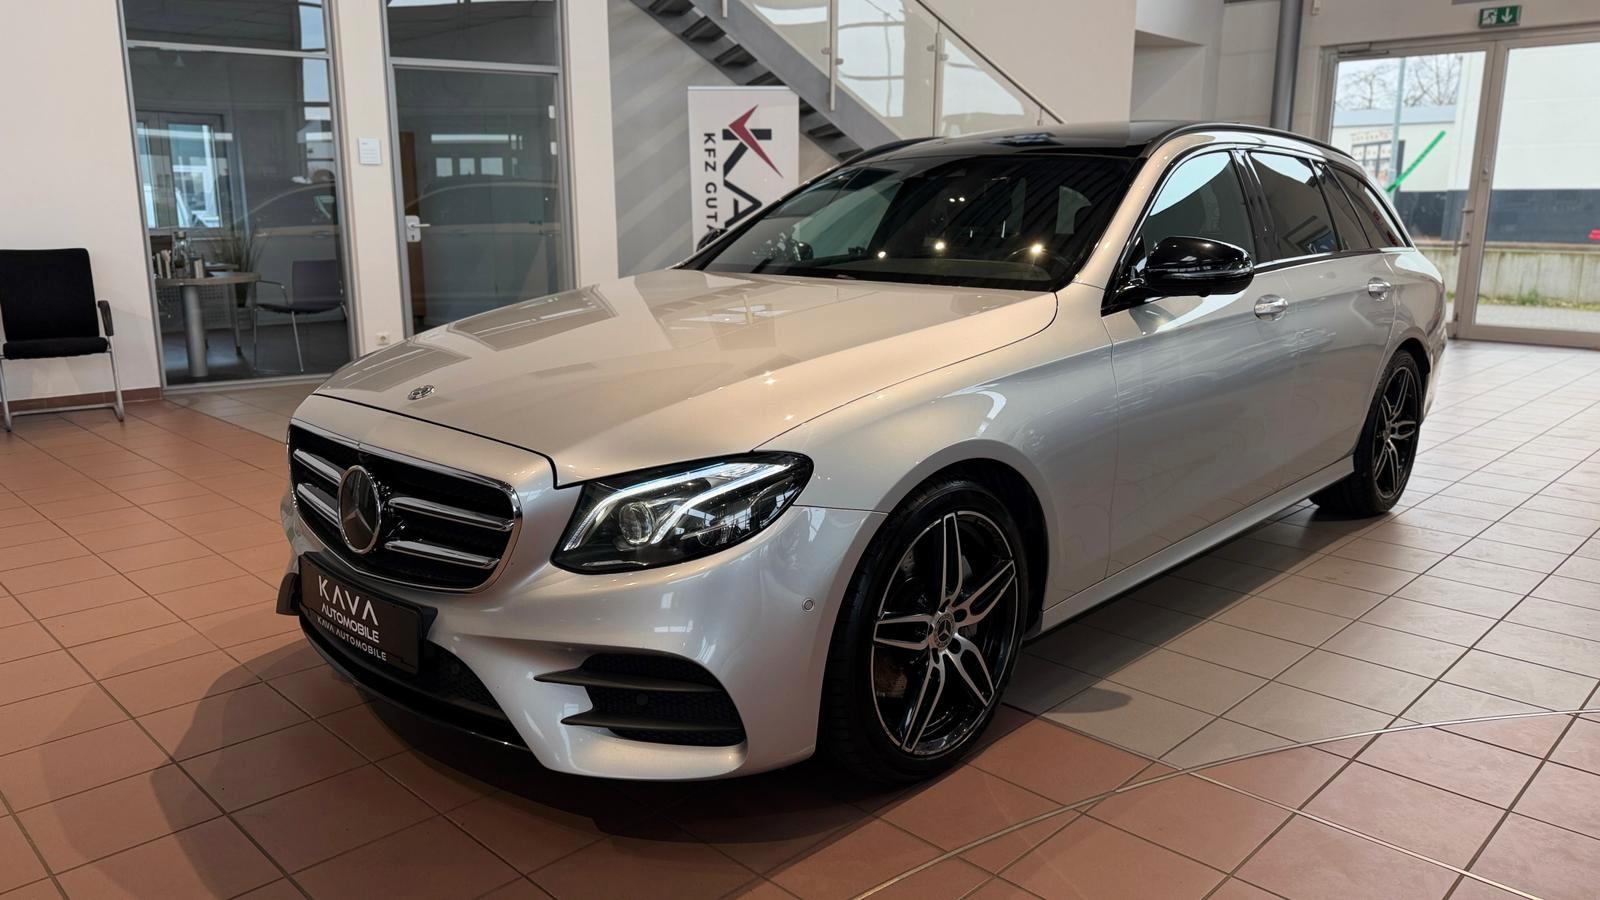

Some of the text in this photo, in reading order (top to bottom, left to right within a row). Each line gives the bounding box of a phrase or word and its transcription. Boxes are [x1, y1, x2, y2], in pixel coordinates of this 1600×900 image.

[703, 132, 717, 173] KFZ
[318, 575, 379, 626] KAVA
[317, 615, 387, 662] KAVA AUTOMOBILE
[321, 603, 380, 643] AUTOMOBILE
